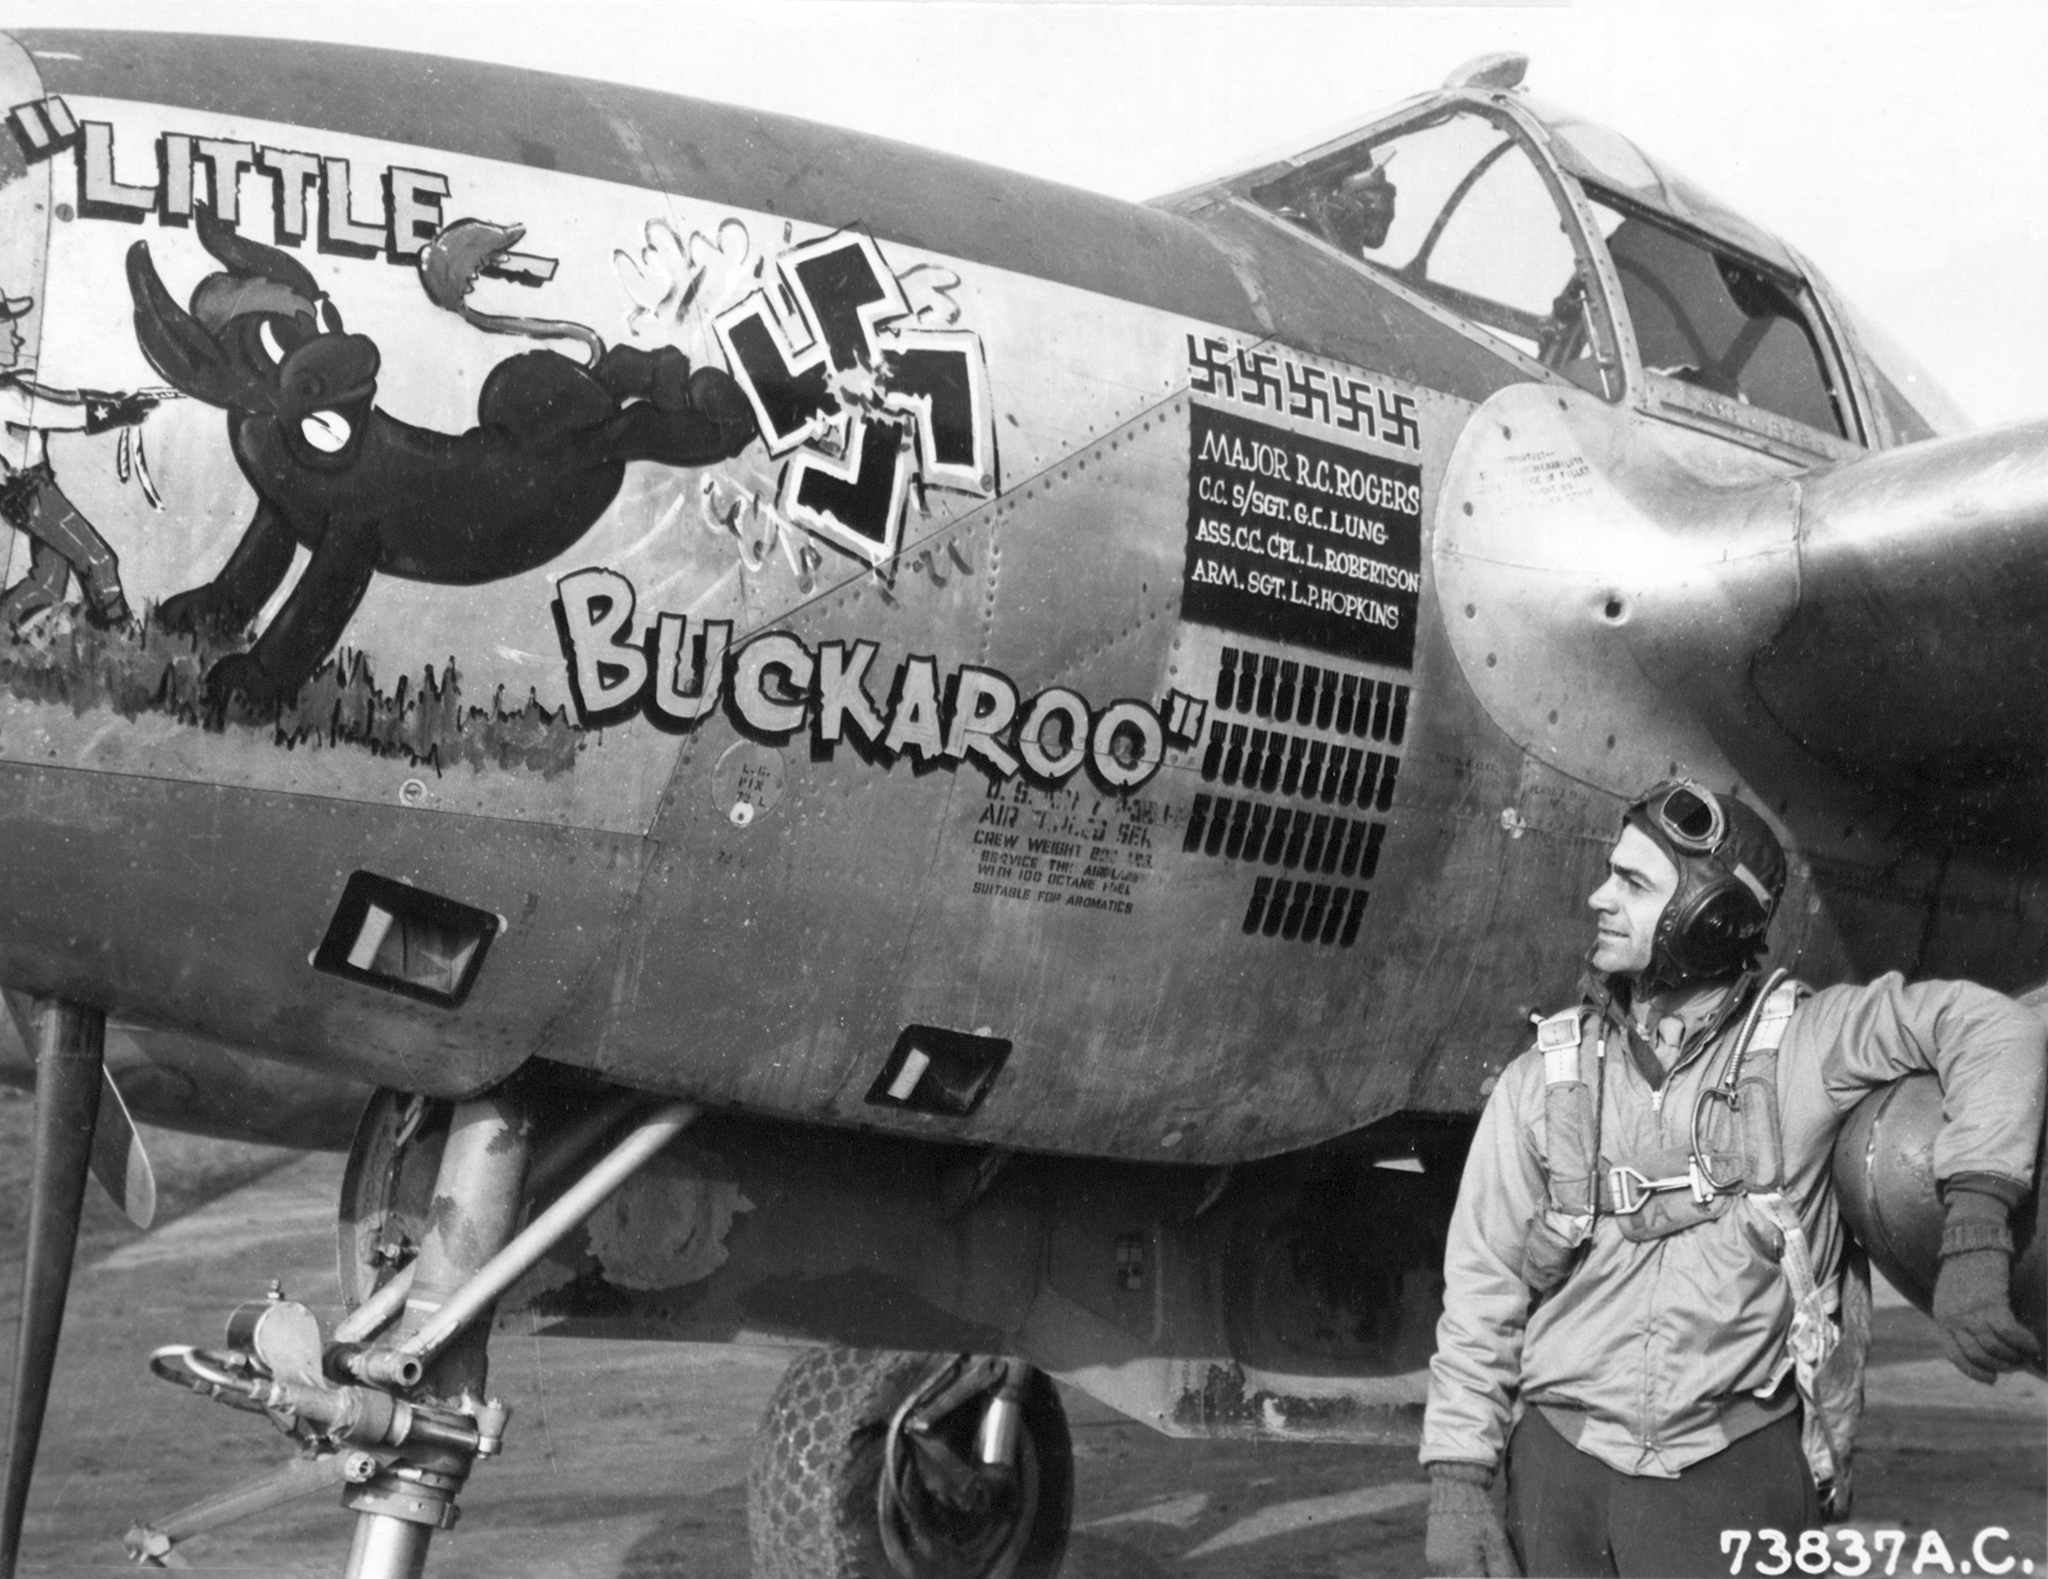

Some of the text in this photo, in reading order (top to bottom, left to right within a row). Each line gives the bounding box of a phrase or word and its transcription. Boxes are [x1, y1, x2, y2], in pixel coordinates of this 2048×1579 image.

[1198, 429, 1291, 481] MAJOR
[1232, 480, 1291, 520] S/SGT.
[1191, 558, 1245, 591] ARM.
[1248, 571, 1287, 602] SGT.
[978, 802, 1020, 828] AIR
[973, 830, 1020, 849] CREW
[1028, 837, 1082, 858] WEIGHT
[978, 863, 1131, 897] WITH 100 OCTANE FUEL
[972, 881, 1134, 915] SUITABLE FOR AROMATICS
